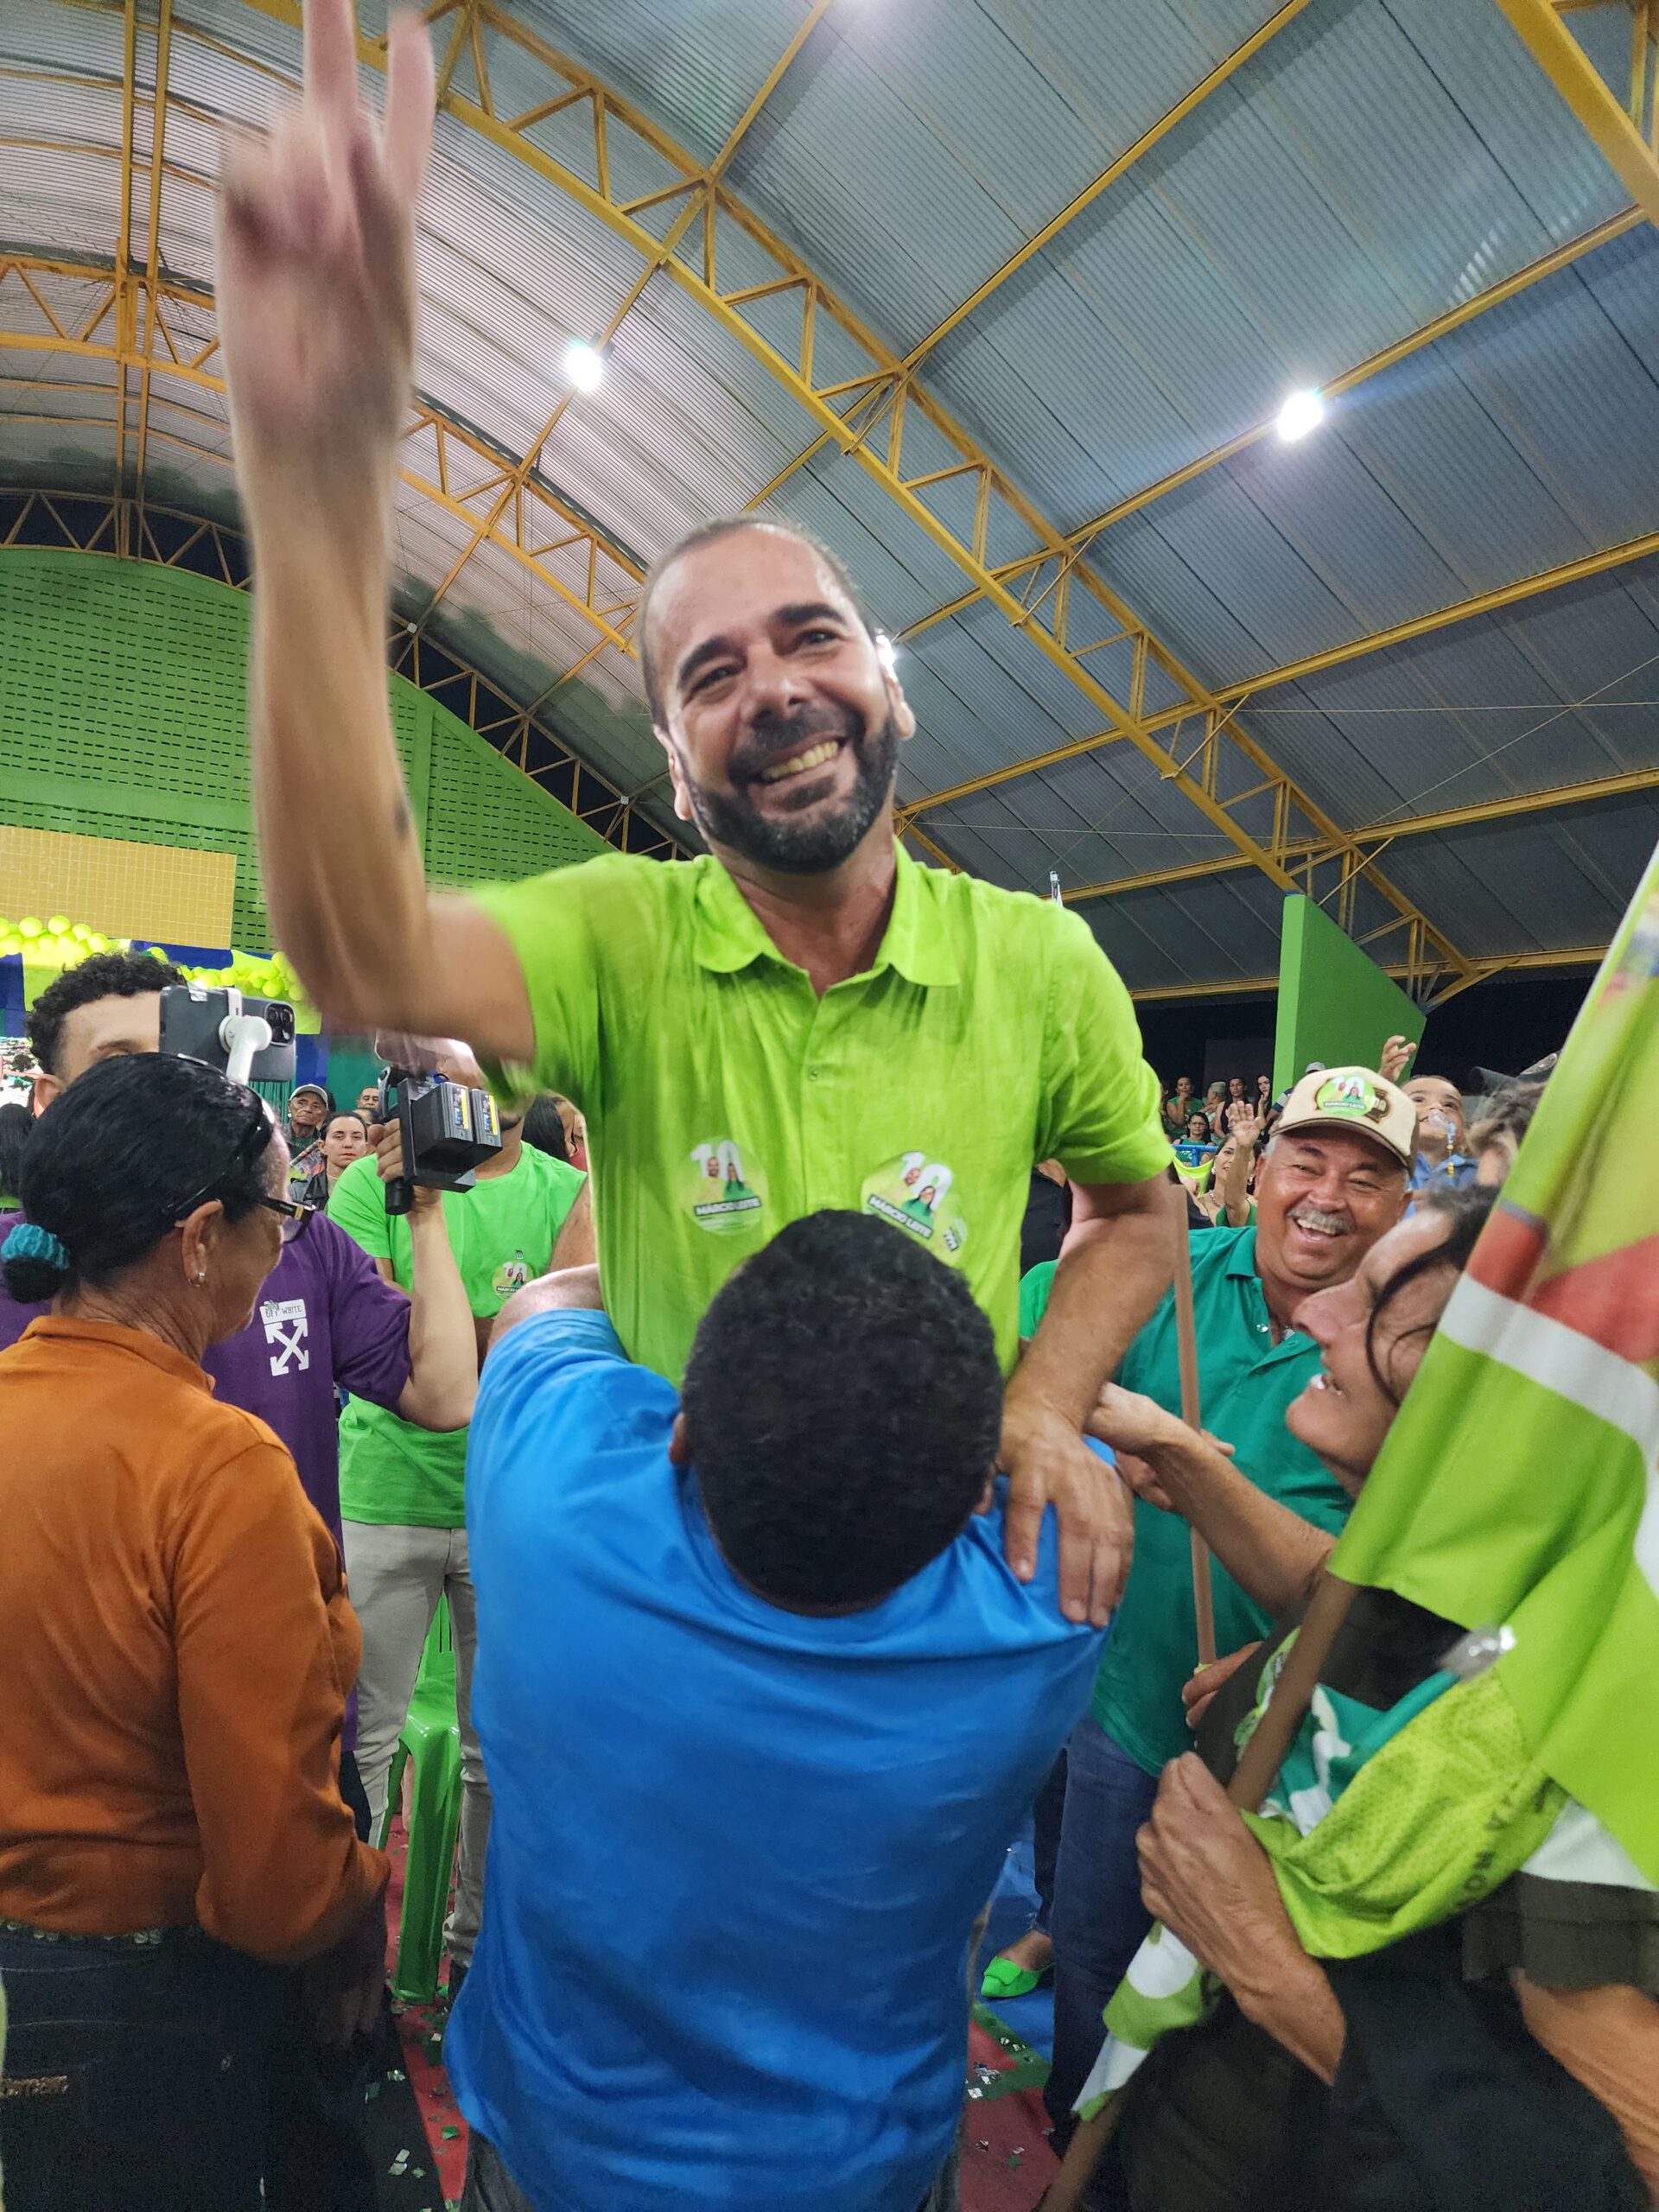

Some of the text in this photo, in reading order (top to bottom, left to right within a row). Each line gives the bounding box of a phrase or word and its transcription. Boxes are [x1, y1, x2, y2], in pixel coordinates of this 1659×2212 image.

[691, 1140, 744, 1182] 10
[899, 1151, 953, 1211] 10
[905, 1217, 933, 1239] LEITE
[282, 1305, 302, 1314] WHITE
